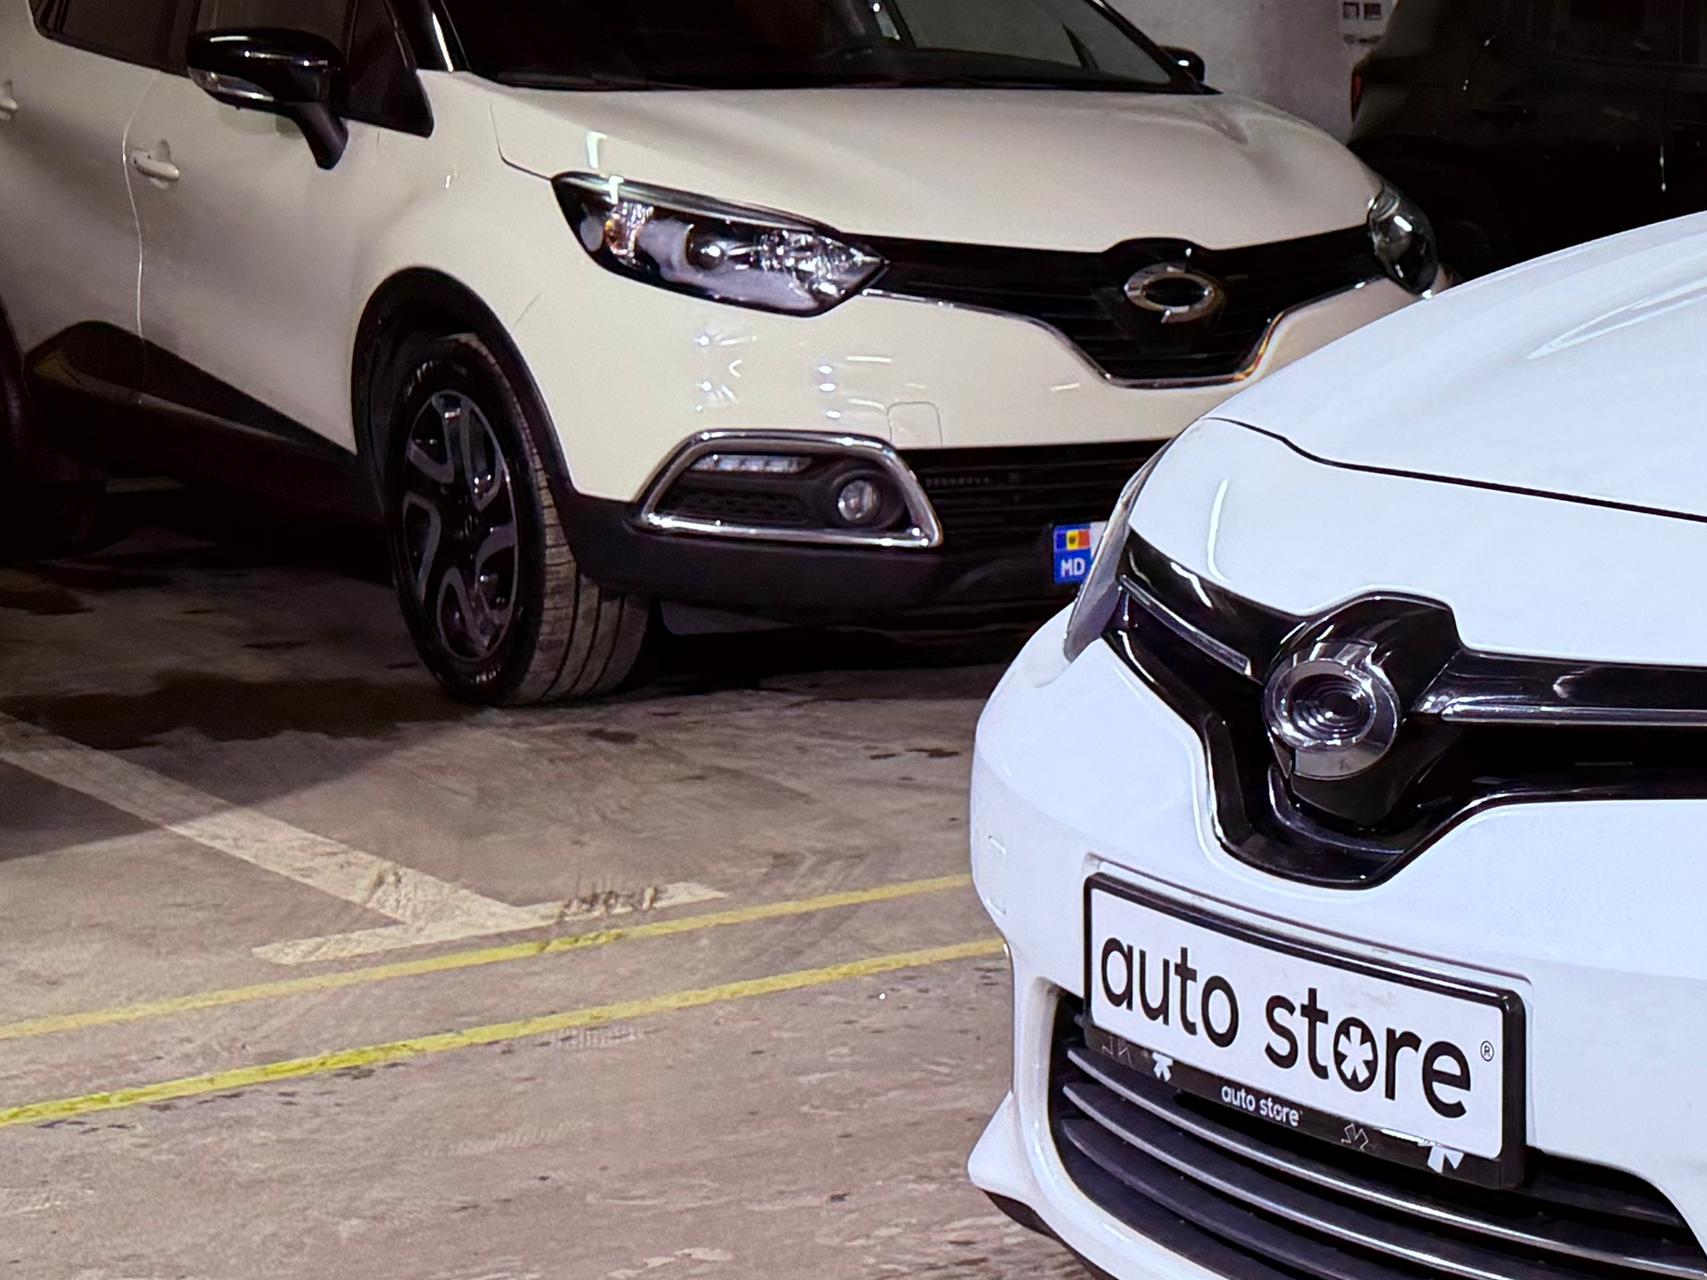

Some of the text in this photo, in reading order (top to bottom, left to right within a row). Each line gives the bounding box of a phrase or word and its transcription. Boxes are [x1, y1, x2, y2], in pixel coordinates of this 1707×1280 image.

[1060, 558, 1085, 577] MD
[1100, 936, 1472, 1120] auto store
[1221, 1084, 1300, 1127] auto store
